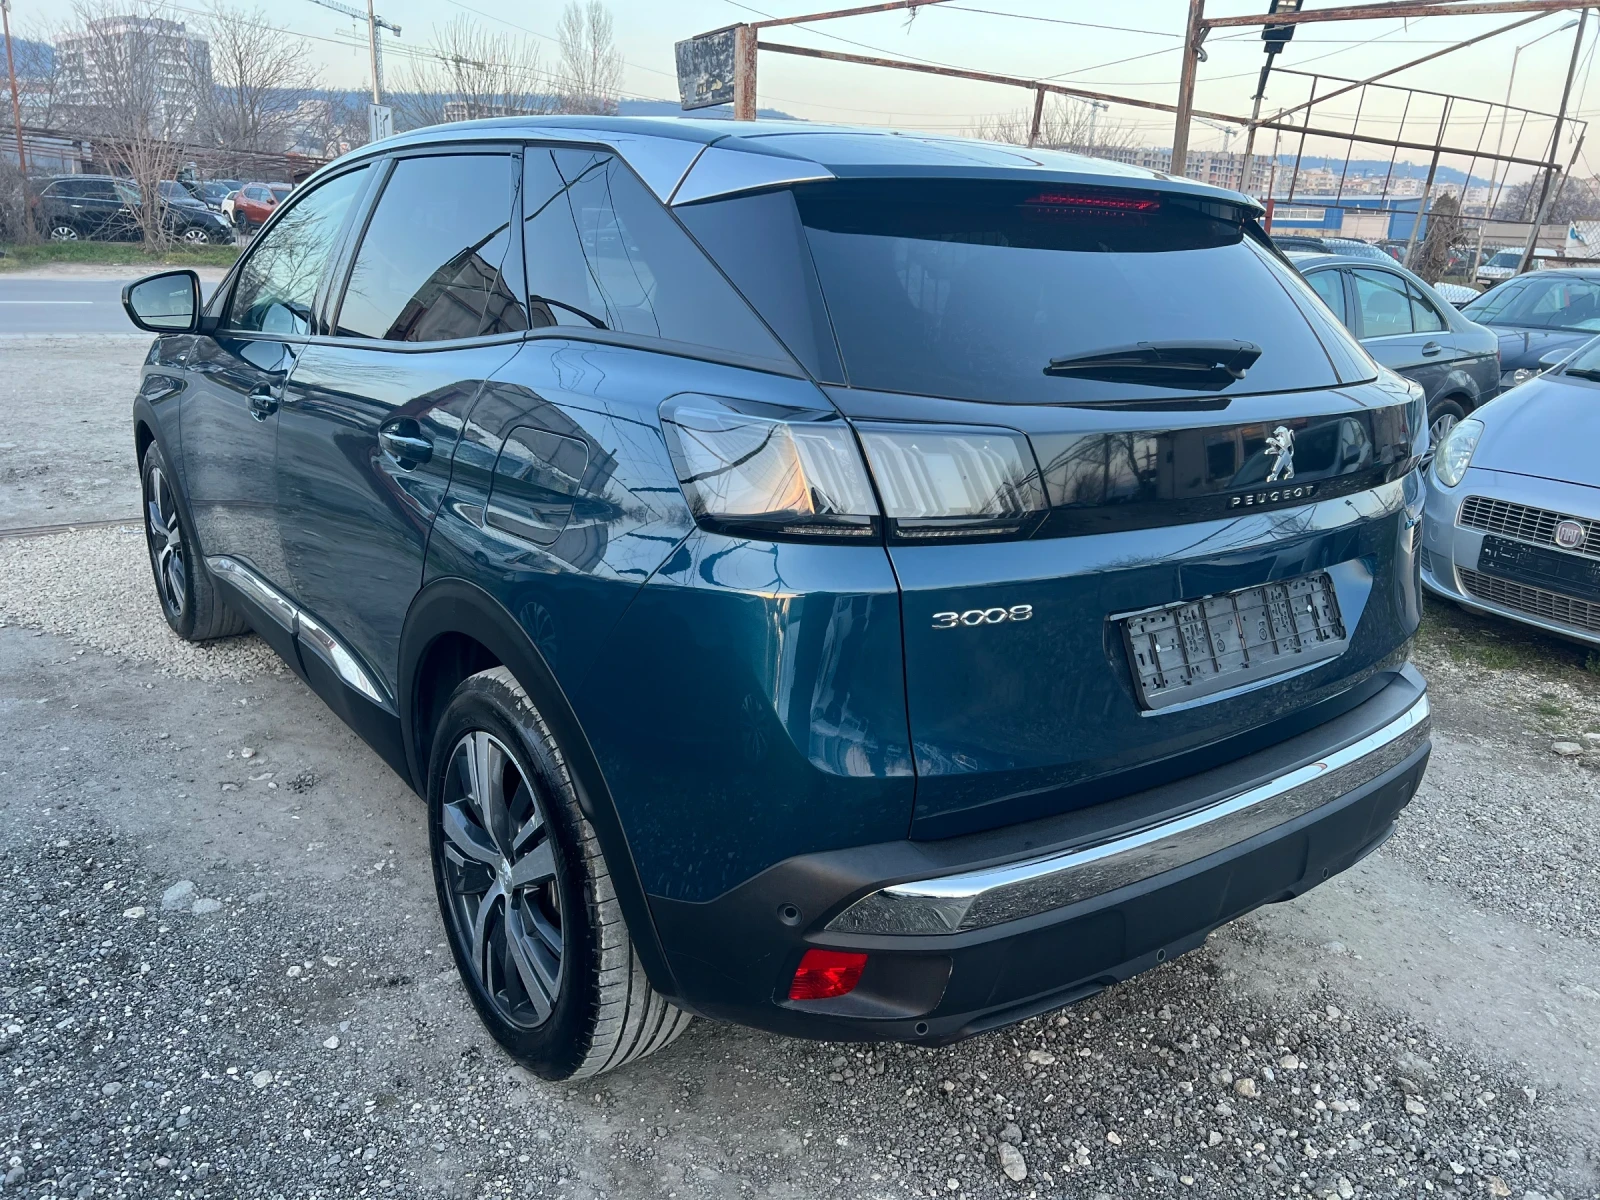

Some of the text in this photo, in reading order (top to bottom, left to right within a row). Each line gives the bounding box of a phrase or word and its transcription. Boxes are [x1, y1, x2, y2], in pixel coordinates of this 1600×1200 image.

[1231, 485, 1314, 507] PEUGEOT
[1560, 527, 1579, 542] FIAT
[931, 604, 1033, 629] 3008
